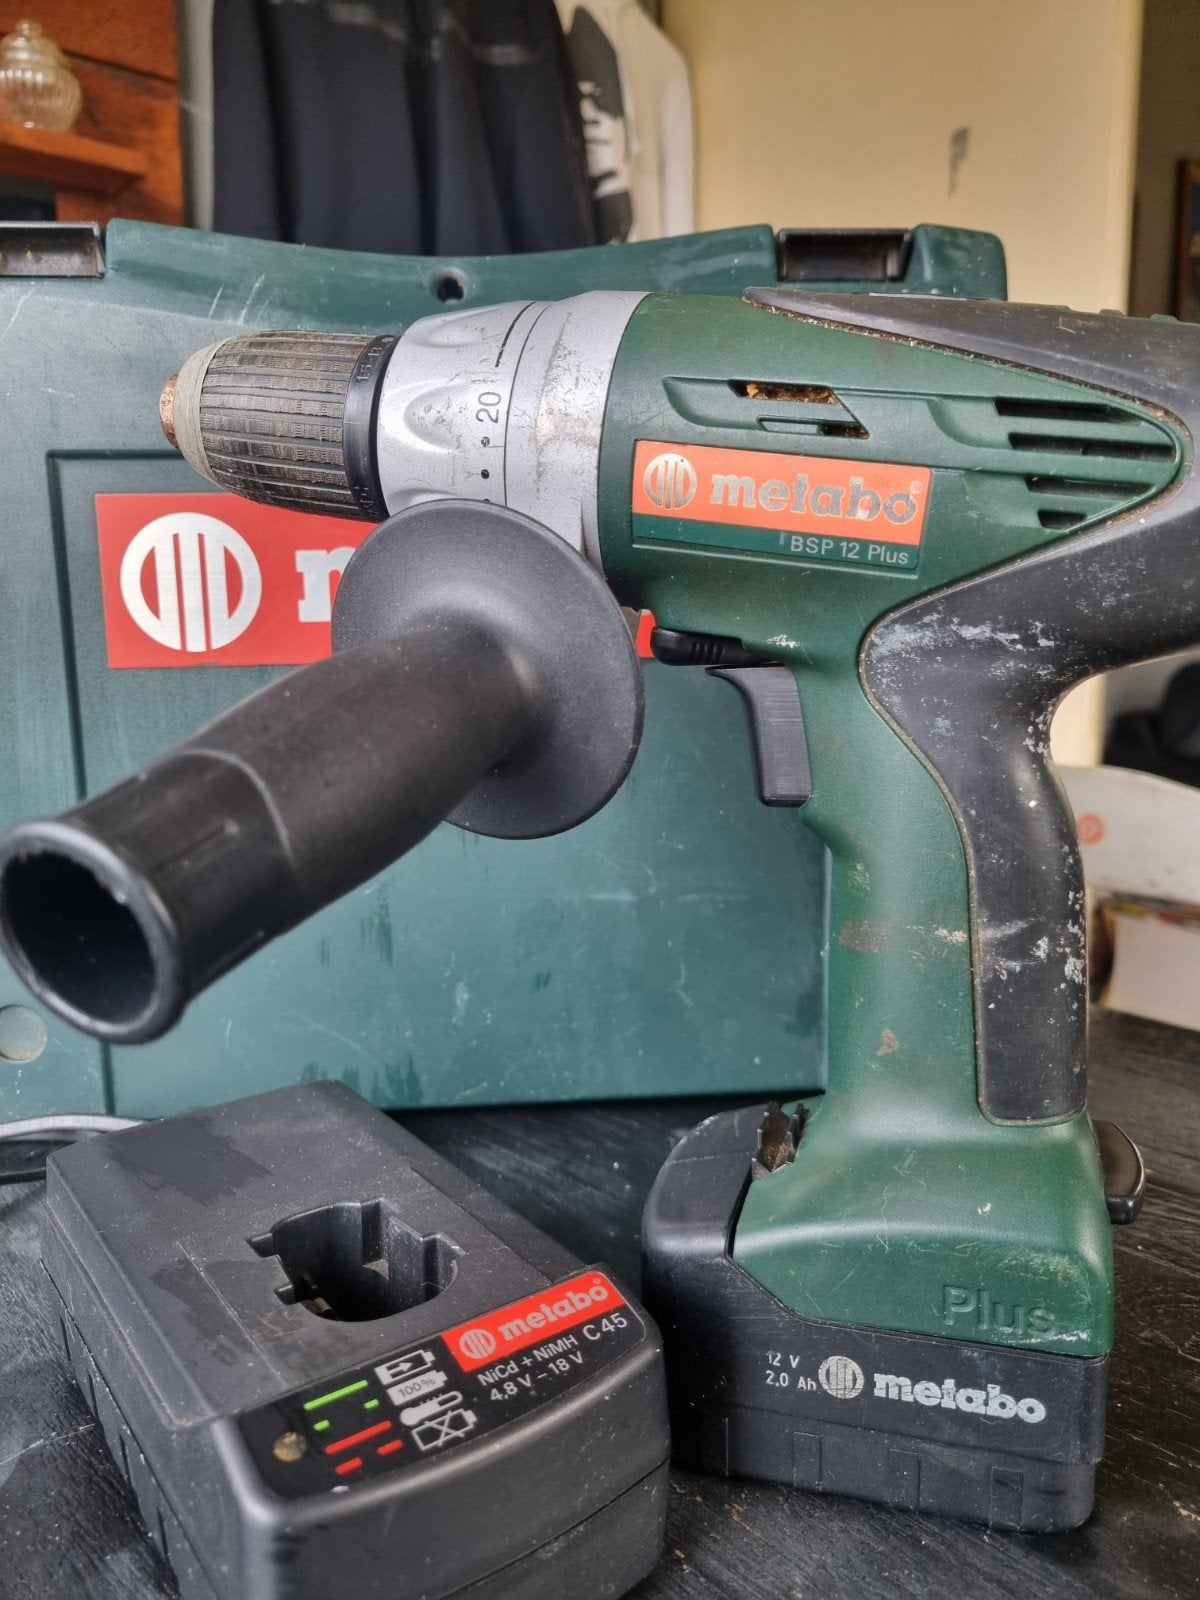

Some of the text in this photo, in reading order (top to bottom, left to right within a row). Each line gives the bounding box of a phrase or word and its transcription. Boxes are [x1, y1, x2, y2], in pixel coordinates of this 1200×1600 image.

[476, 391, 501, 423] 20
[710, 472, 917, 525] metabo
[791, 535, 909, 565] BSP 12 Plus
[498, 1285, 608, 1341] metabo
[943, 1285, 1056, 1337] Plus
[477, 1359, 519, 1386] NiCd
[533, 1334, 579, 1362] NiMH
[517, 1373, 533, 1388] V
[548, 1357, 570, 1375] 18
[569, 1350, 583, 1365] V
[766, 1350, 800, 1369] 12 V
[797, 1376, 817, 1391] Ah
[873, 1373, 1046, 1423] metabo
